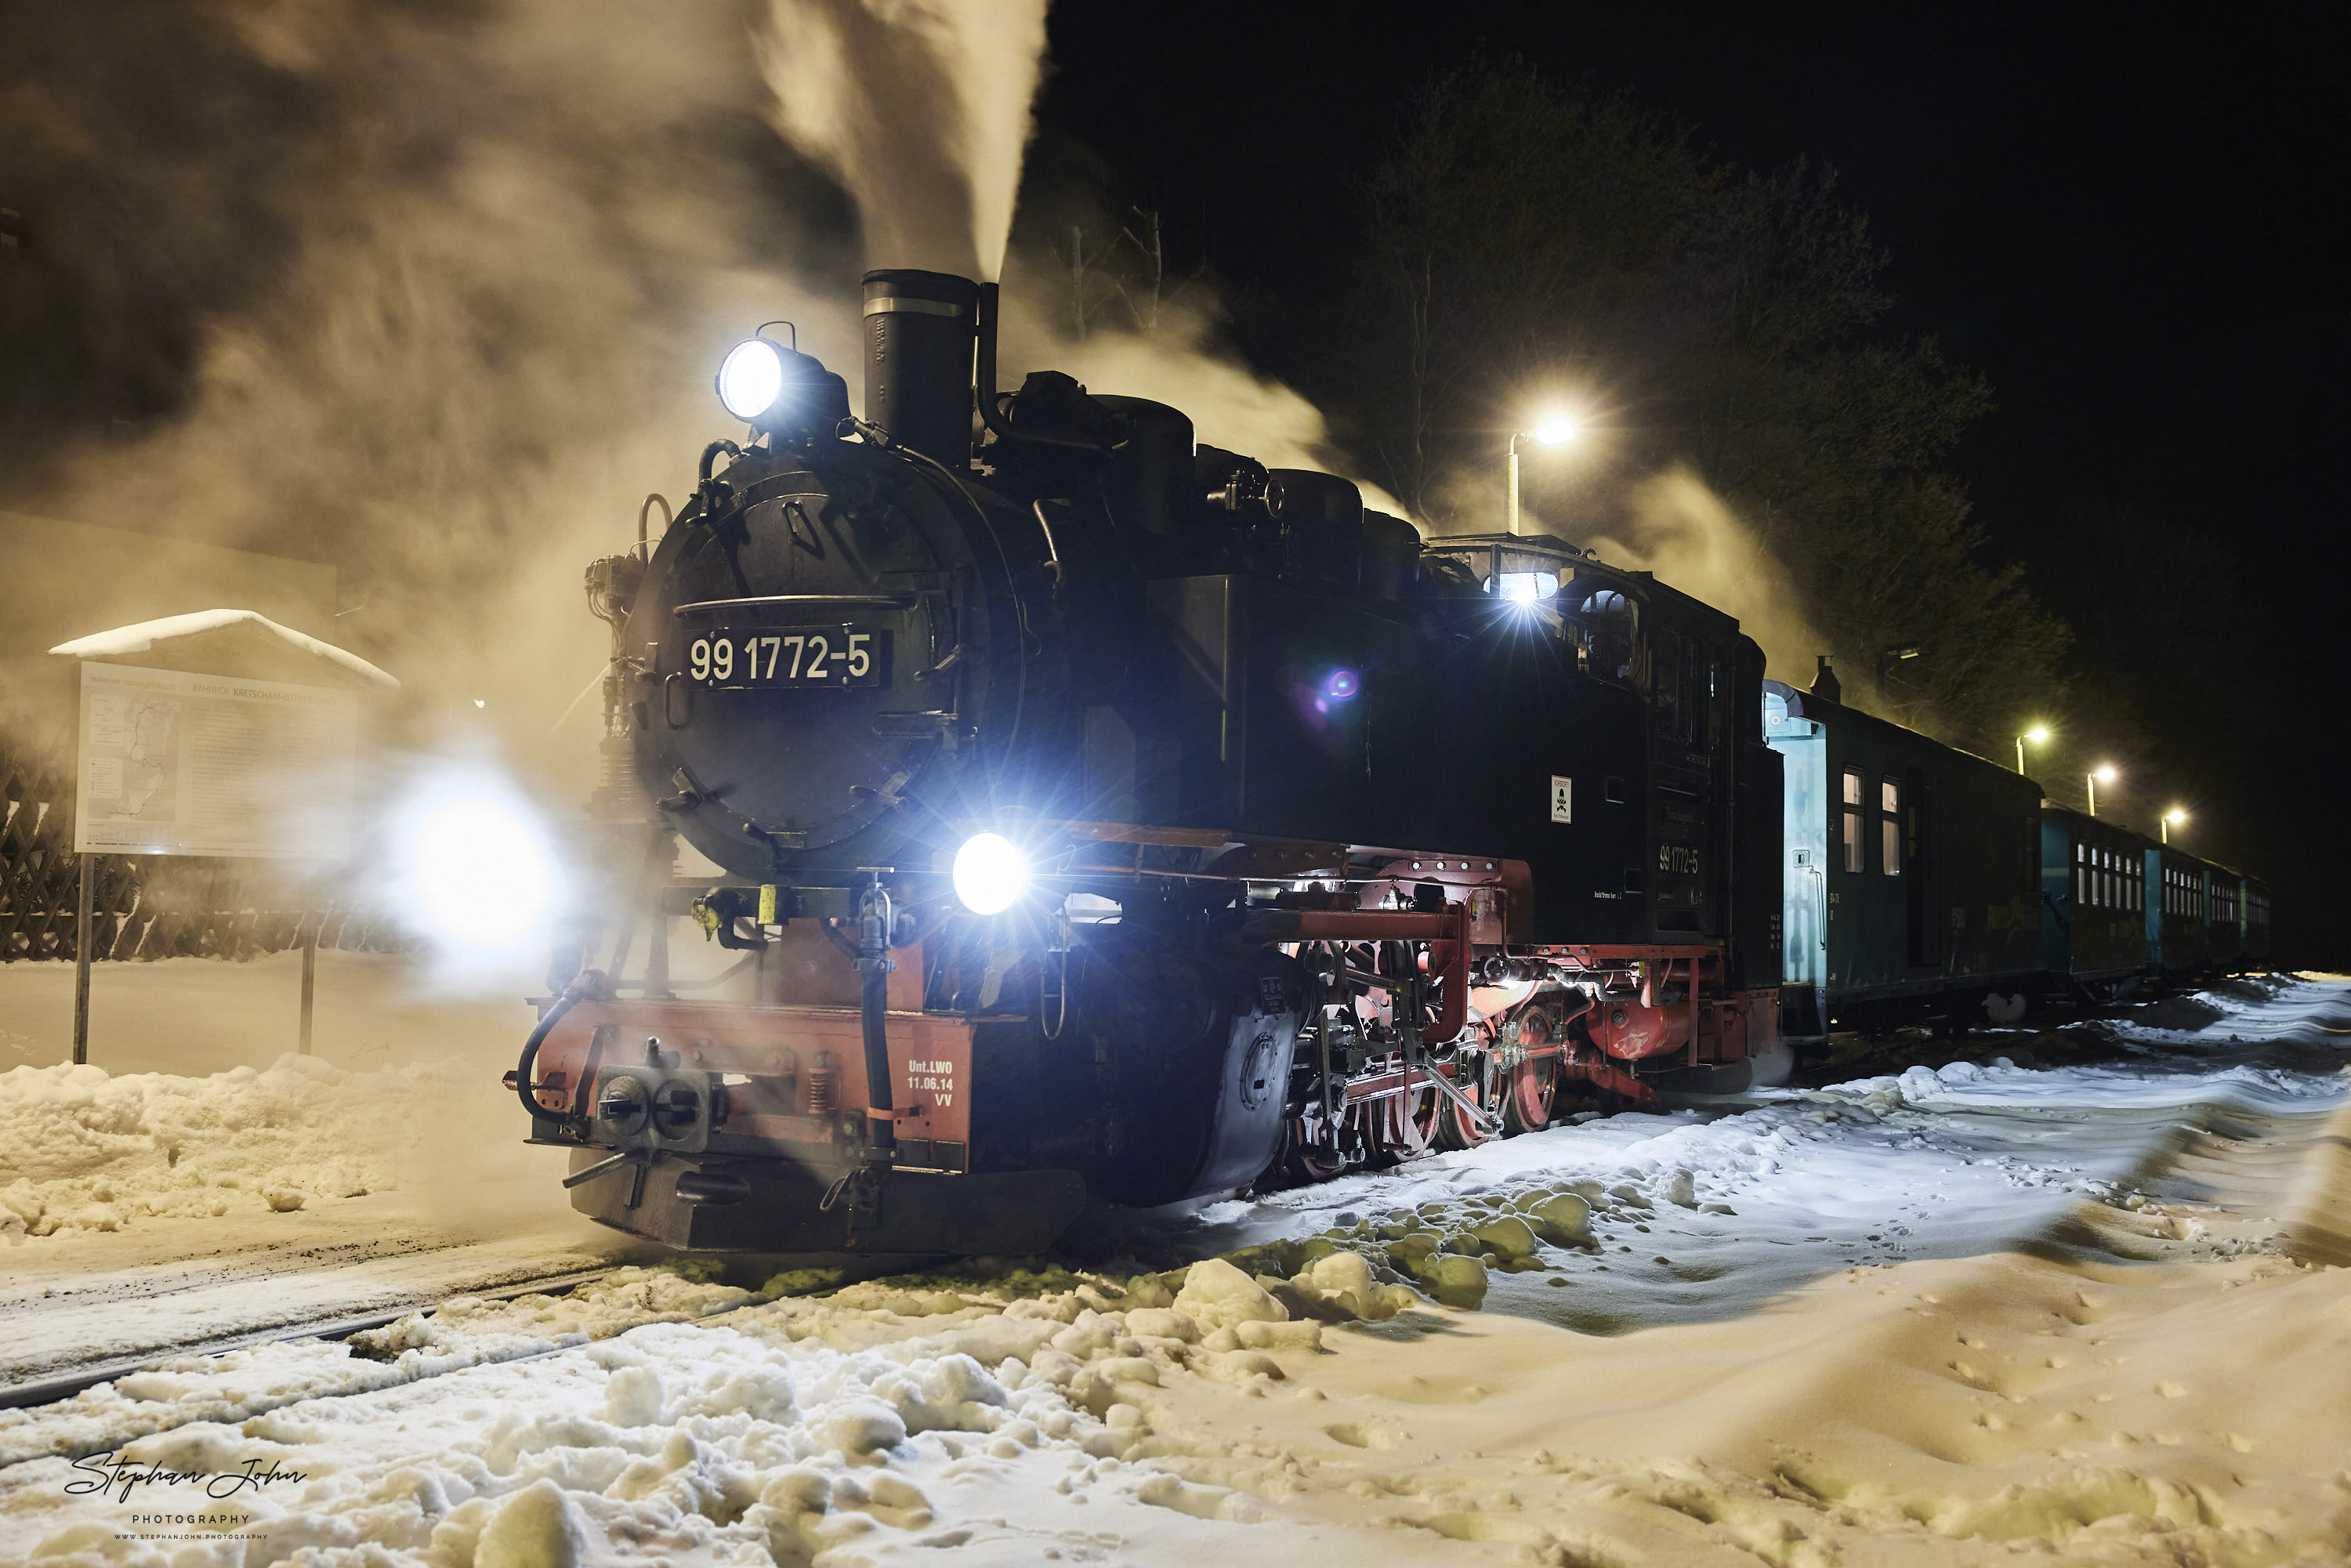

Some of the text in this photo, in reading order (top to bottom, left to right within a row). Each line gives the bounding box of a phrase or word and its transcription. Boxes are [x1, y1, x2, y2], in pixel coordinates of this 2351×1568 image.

[690, 634, 871, 681] 99 1772-5
[192, 683, 230, 696] BAHNHOF
[1660, 844, 1698, 874] 99 1772-5
[908, 1059, 952, 1074] Unt.LWO
[907, 1076, 954, 1091] 11.06.14
